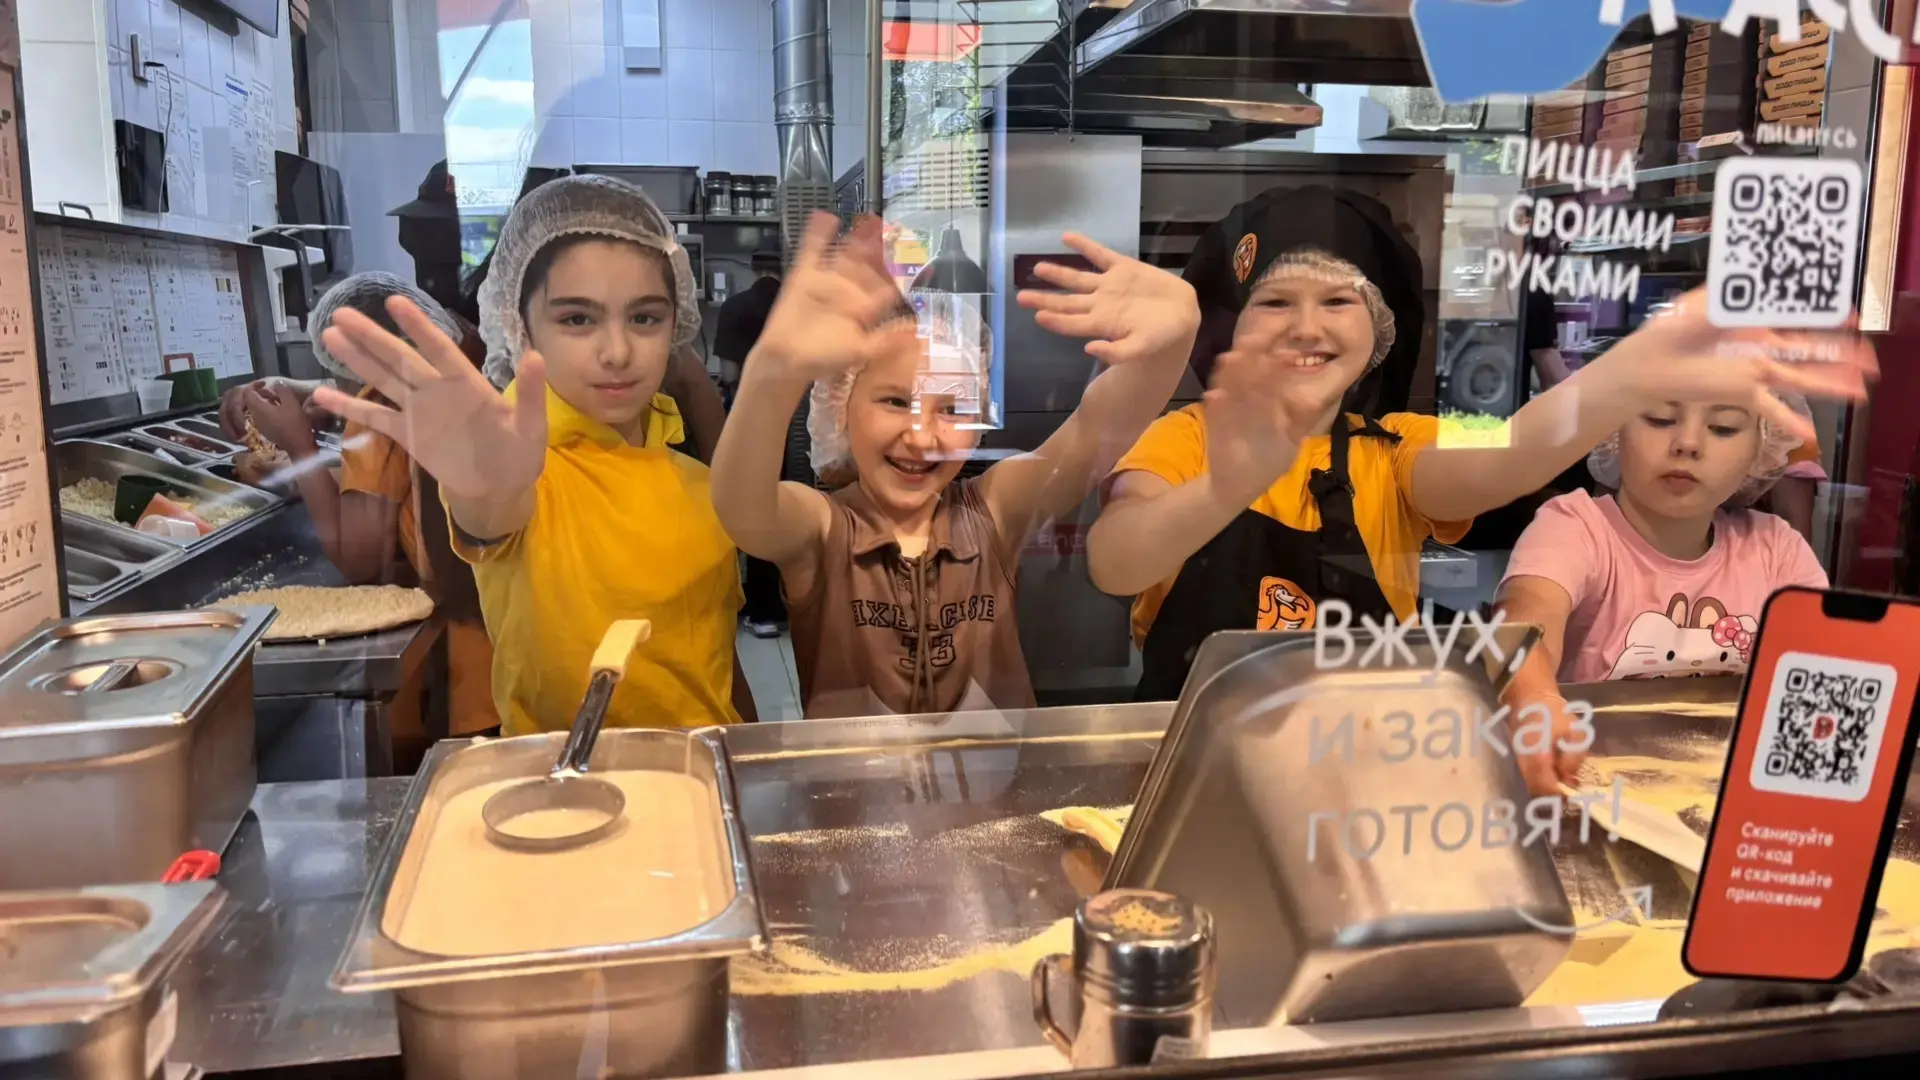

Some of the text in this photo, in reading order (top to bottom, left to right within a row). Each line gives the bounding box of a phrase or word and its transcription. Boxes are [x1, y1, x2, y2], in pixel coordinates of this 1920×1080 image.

[1500, 134, 1637, 196] ПИЦЦА
[1507, 194, 1675, 252] СВОИМИ
[1484, 248, 1641, 303] РУКАМИ
[1314, 599, 1526, 685] Вжух,
[1308, 699, 1597, 766] и заказ
[1305, 775, 1625, 864] готовят!
[1741, 821, 1834, 847] Сканируйте
[1730, 866, 1833, 889] и скачивайте
[1736, 842, 1794, 866] QR-код
[1725, 886, 1822, 909] приложение
